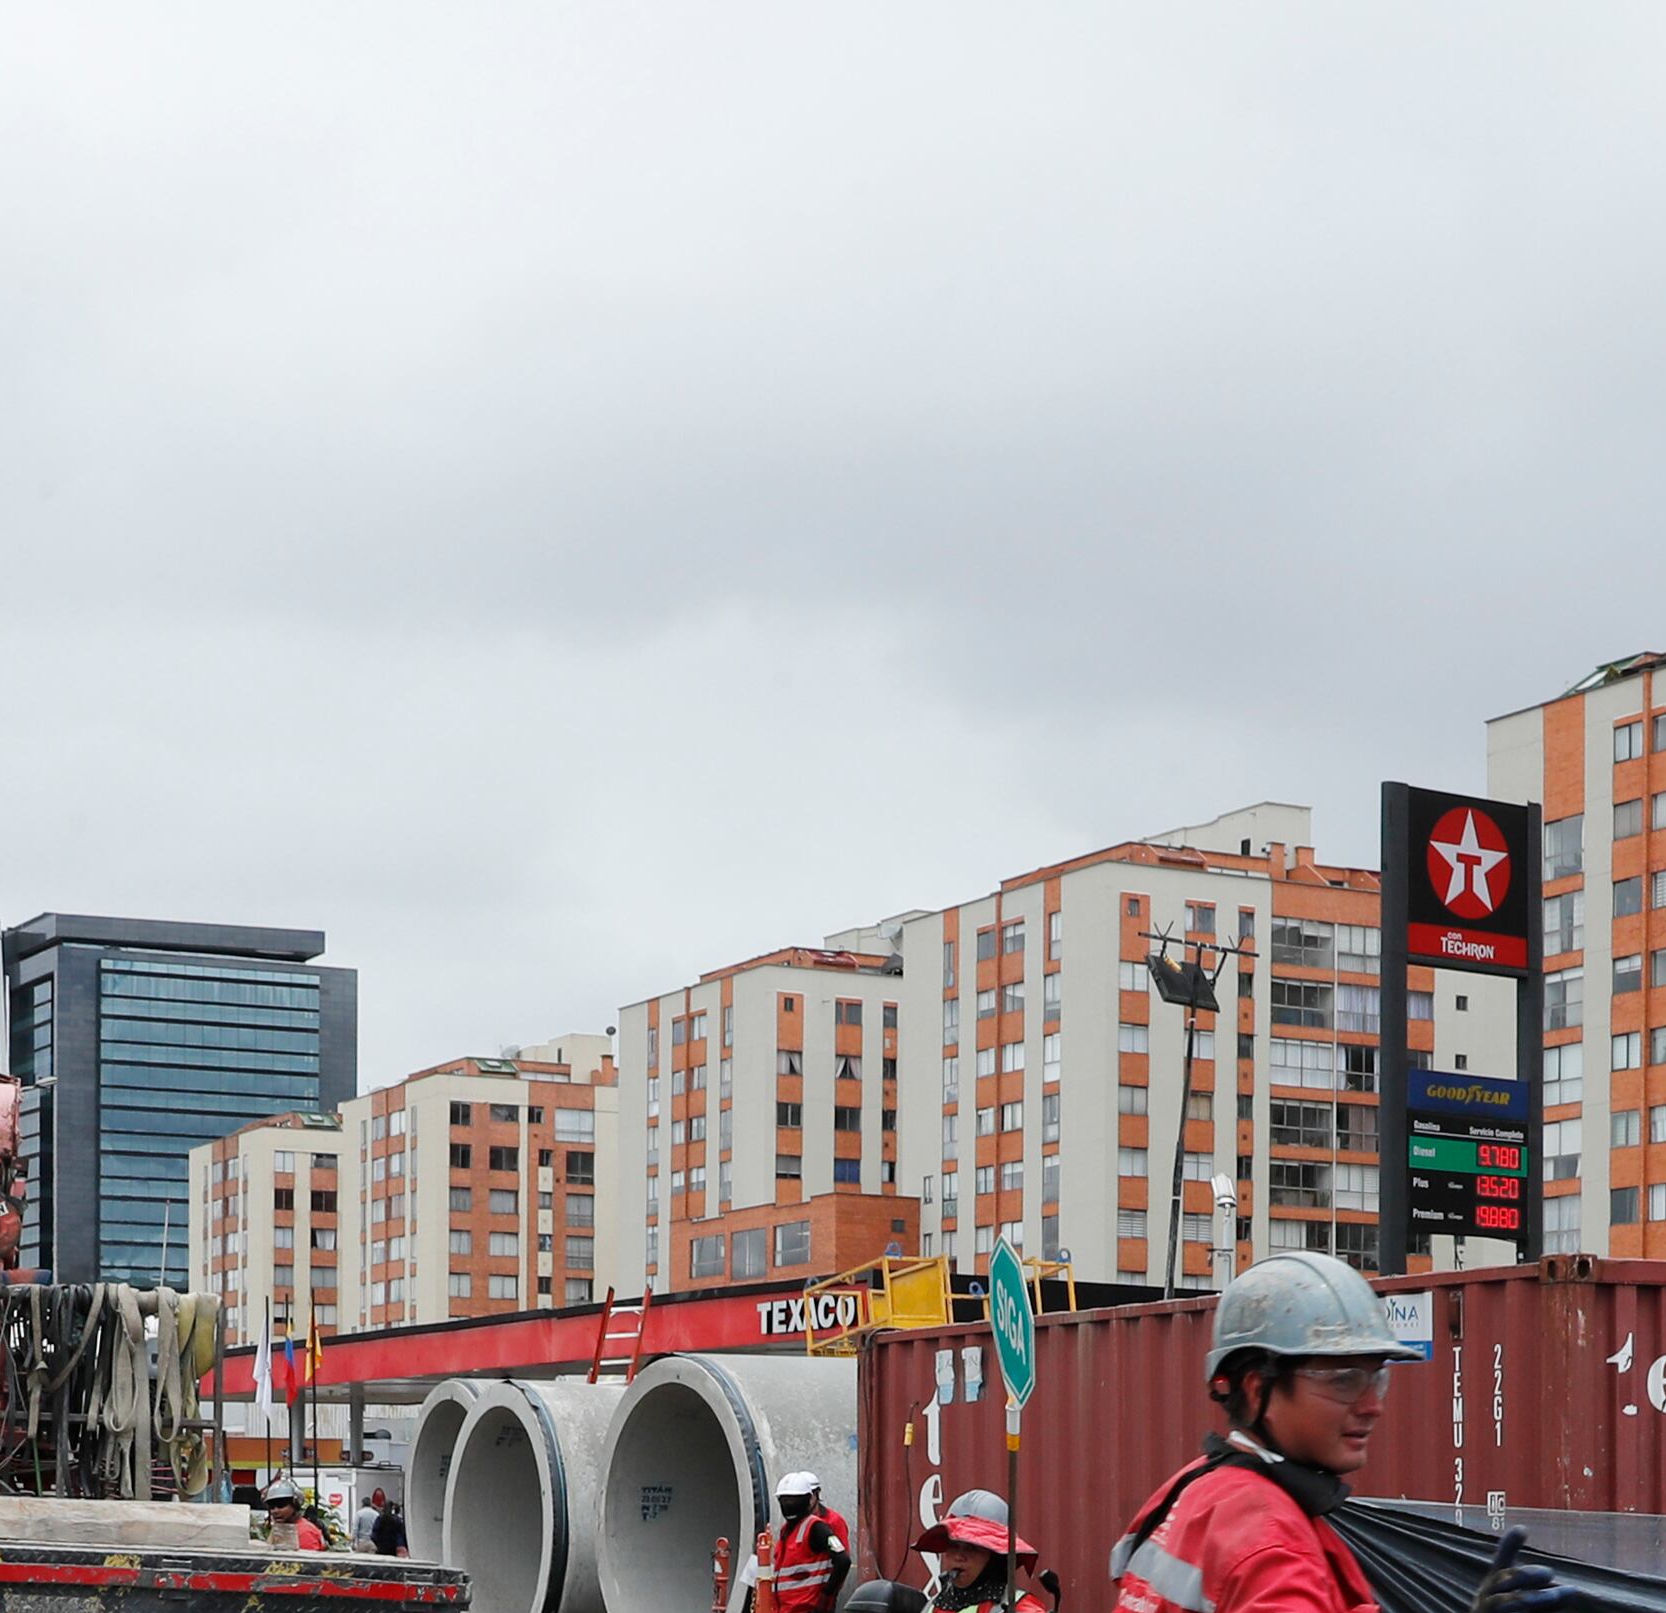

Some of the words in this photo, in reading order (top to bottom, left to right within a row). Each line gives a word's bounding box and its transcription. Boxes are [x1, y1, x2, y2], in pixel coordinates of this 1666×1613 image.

[1440, 936, 1495, 960] TECHRON
[1413, 1177, 1429, 1189] Plus
[1413, 1207, 1444, 1220] Premium
[756, 1295, 856, 1335] TEXACO
[996, 1279, 1026, 1366] SIGA
[1452, 1346, 1463, 1448] TEMU
[1493, 1343, 1503, 1447] 22G1
